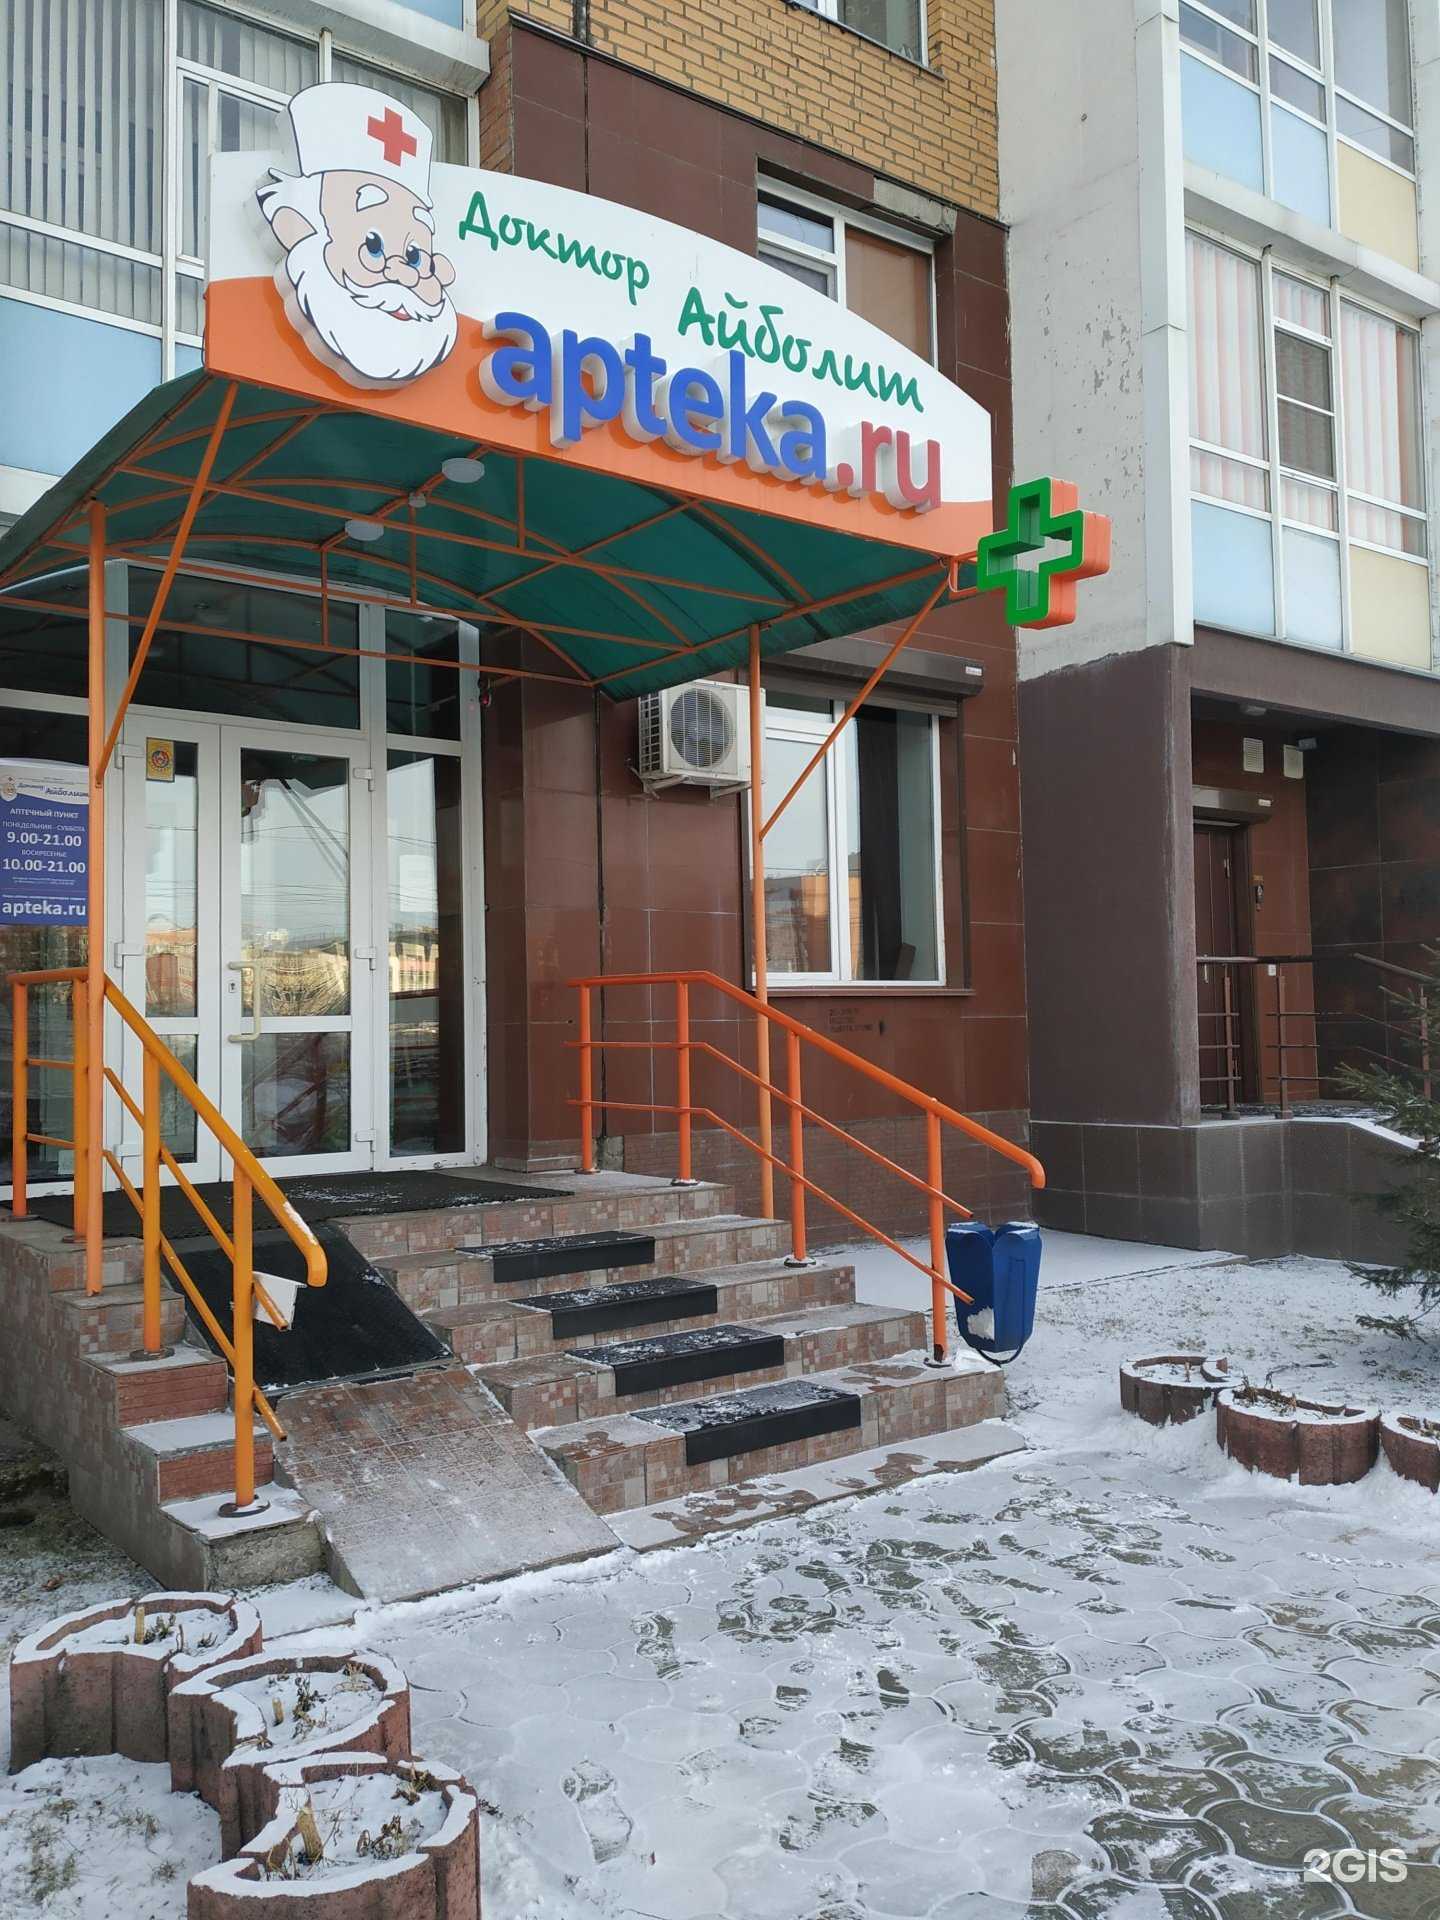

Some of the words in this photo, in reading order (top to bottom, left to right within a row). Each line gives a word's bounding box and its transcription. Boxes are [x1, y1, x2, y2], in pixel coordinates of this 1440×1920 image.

[458, 190, 651, 306] Доктор
[677, 286, 926, 413] Айболит
[483, 311, 941, 512] apteka.ru
[9, 808, 52, 817] АПТЕЧНЫЙ
[54, 811, 80, 819] ПУНКТ
[7, 831, 82, 847] 9.00-21.00
[2, 858, 86, 873] 10.00-21.00
[2, 900, 86, 917] apteka.ru
